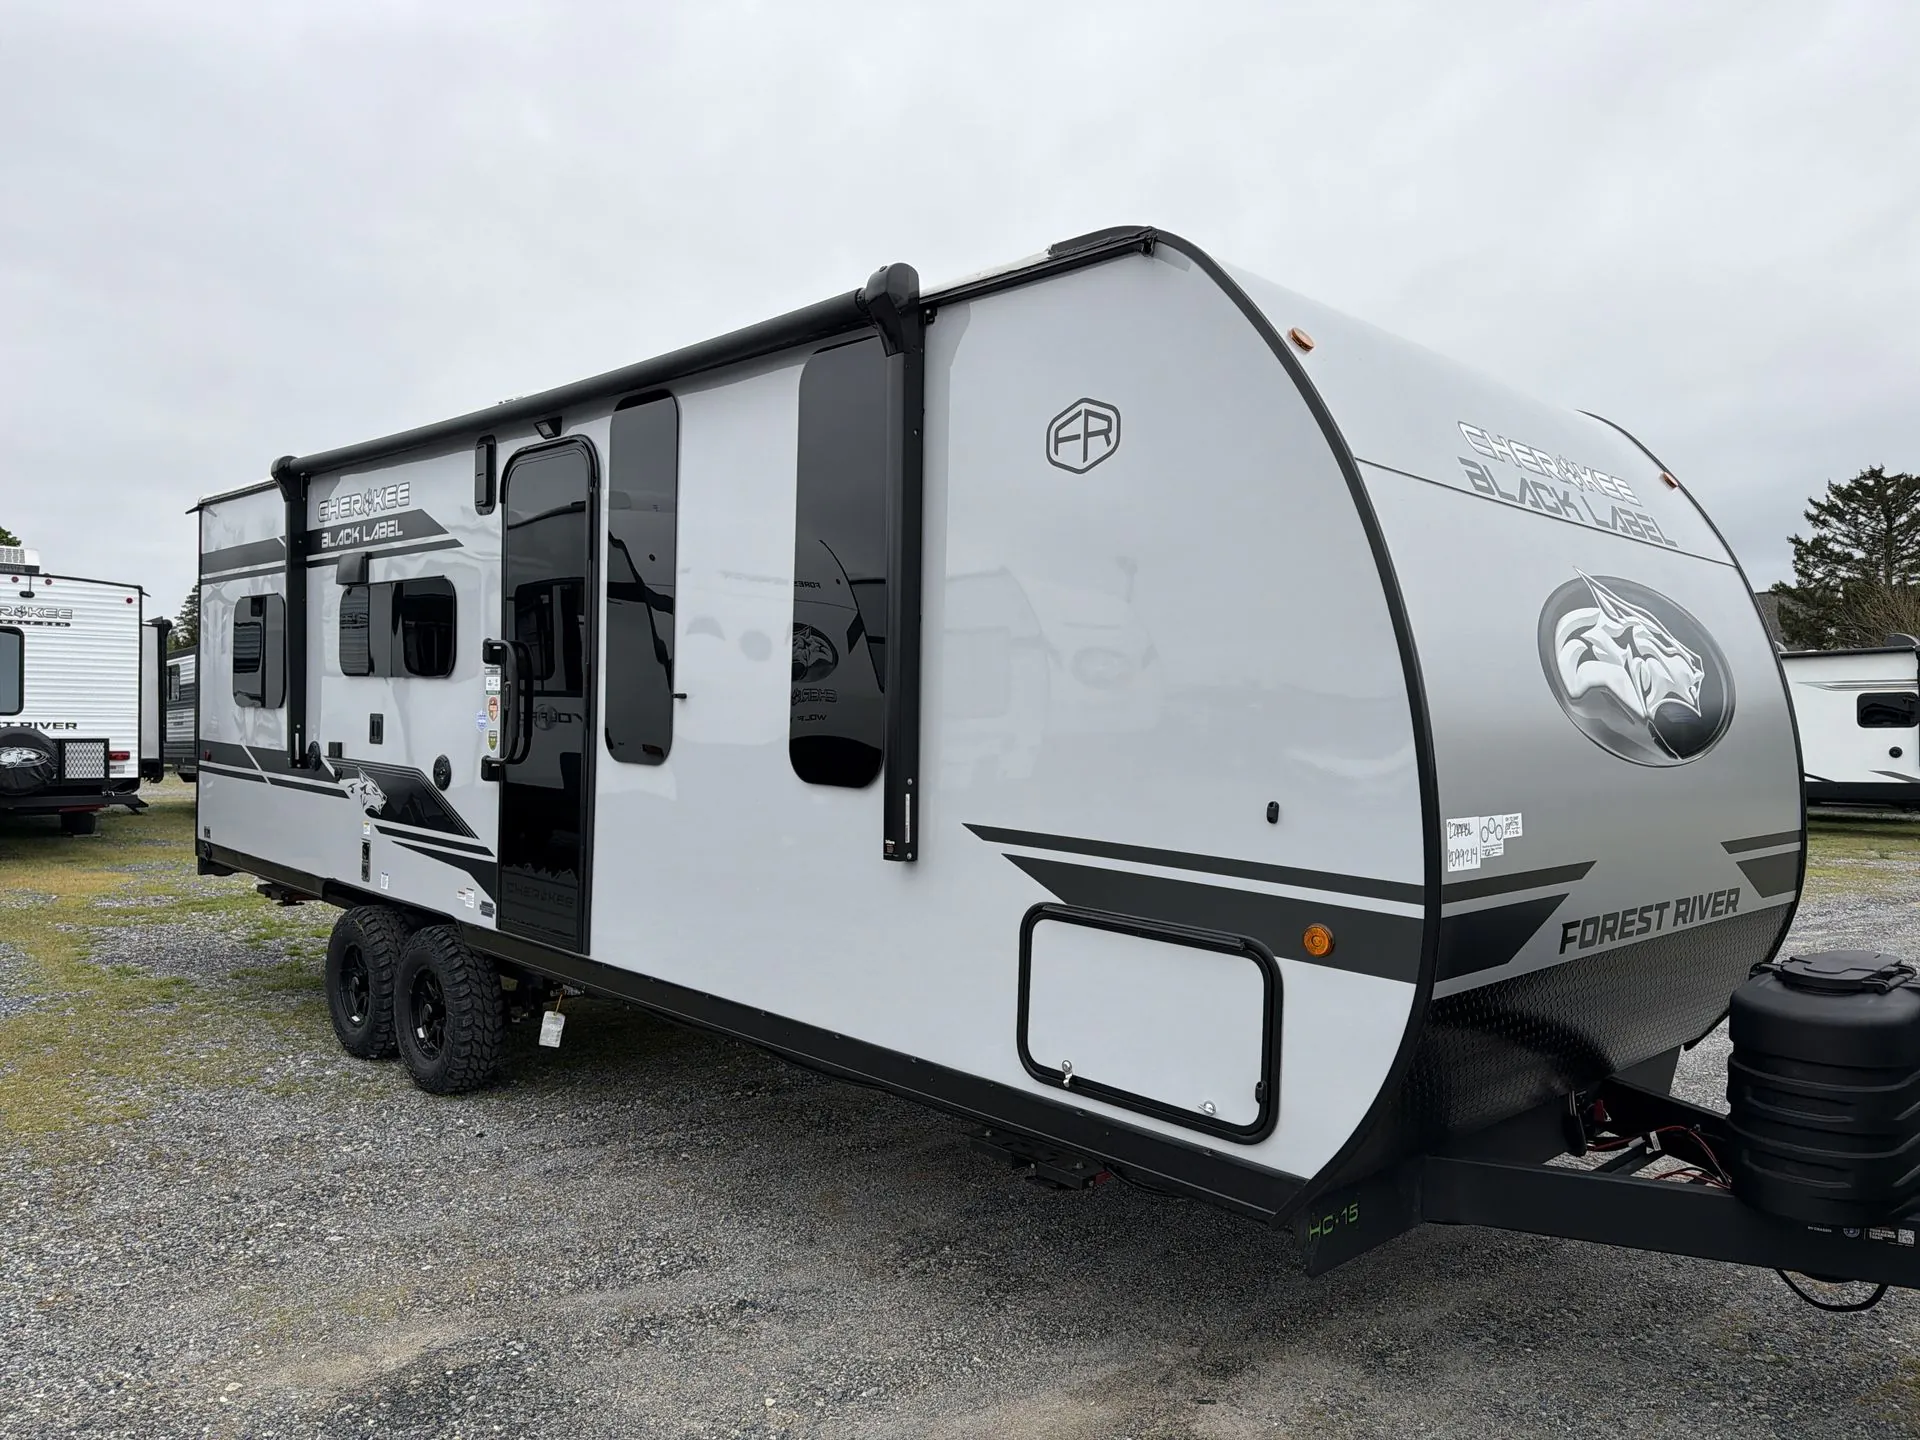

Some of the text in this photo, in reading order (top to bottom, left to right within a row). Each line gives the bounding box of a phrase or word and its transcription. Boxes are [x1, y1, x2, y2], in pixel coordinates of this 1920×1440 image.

[1457, 420, 1643, 507] CHEROKEE
[318, 481, 411, 523] CHEROKEE
[321, 519, 404, 549] BLACK LABEL
[1457, 455, 1679, 547] BLACK LABEL
[1558, 887, 1741, 955] FOREST RIVER
